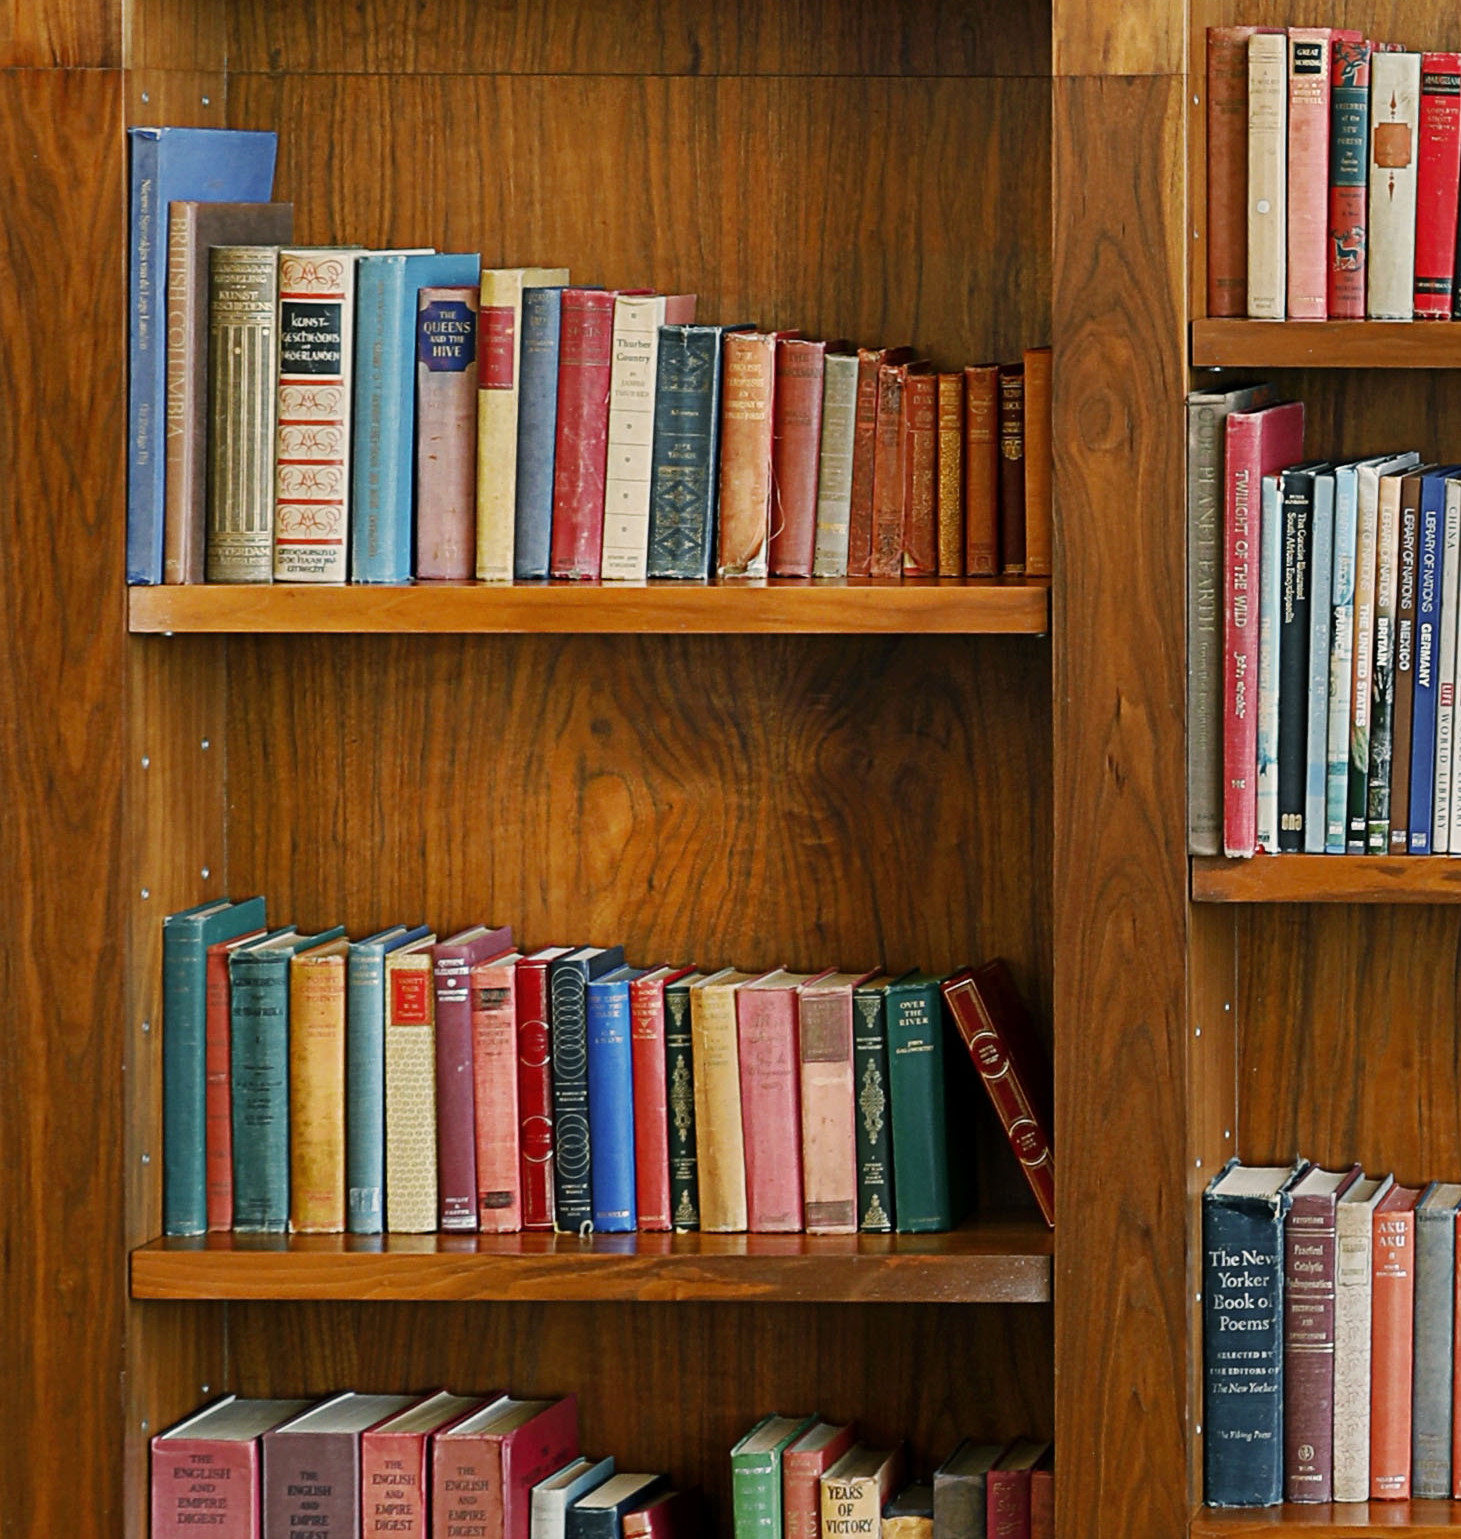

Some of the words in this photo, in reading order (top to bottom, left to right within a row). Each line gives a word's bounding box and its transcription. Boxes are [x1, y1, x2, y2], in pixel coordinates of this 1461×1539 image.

[171, 217, 187, 301] BRITISH
[424, 322, 471, 333] QUEENS
[433, 345, 461, 357] HIVE
[1235, 470, 1250, 536] TWILIGHT
[1234, 540, 1248, 559] OF
[1234, 564, 1248, 590] THE
[1234, 595, 1248, 627] WILD
[1399, 620, 1411, 671] MEXICO
[1419, 623, 1432, 687] GERMANY
[1209, 1251, 1240, 1266] The
[1220, 1273, 1269, 1289] Yorker
[1214, 1295, 1254, 1310] Book
[1220, 1316, 1269, 1331] Poems
[828, 1486, 863, 1500] YEARS
[838, 1503, 854, 1516] OF
[826, 1519, 873, 1534] VICTORY
